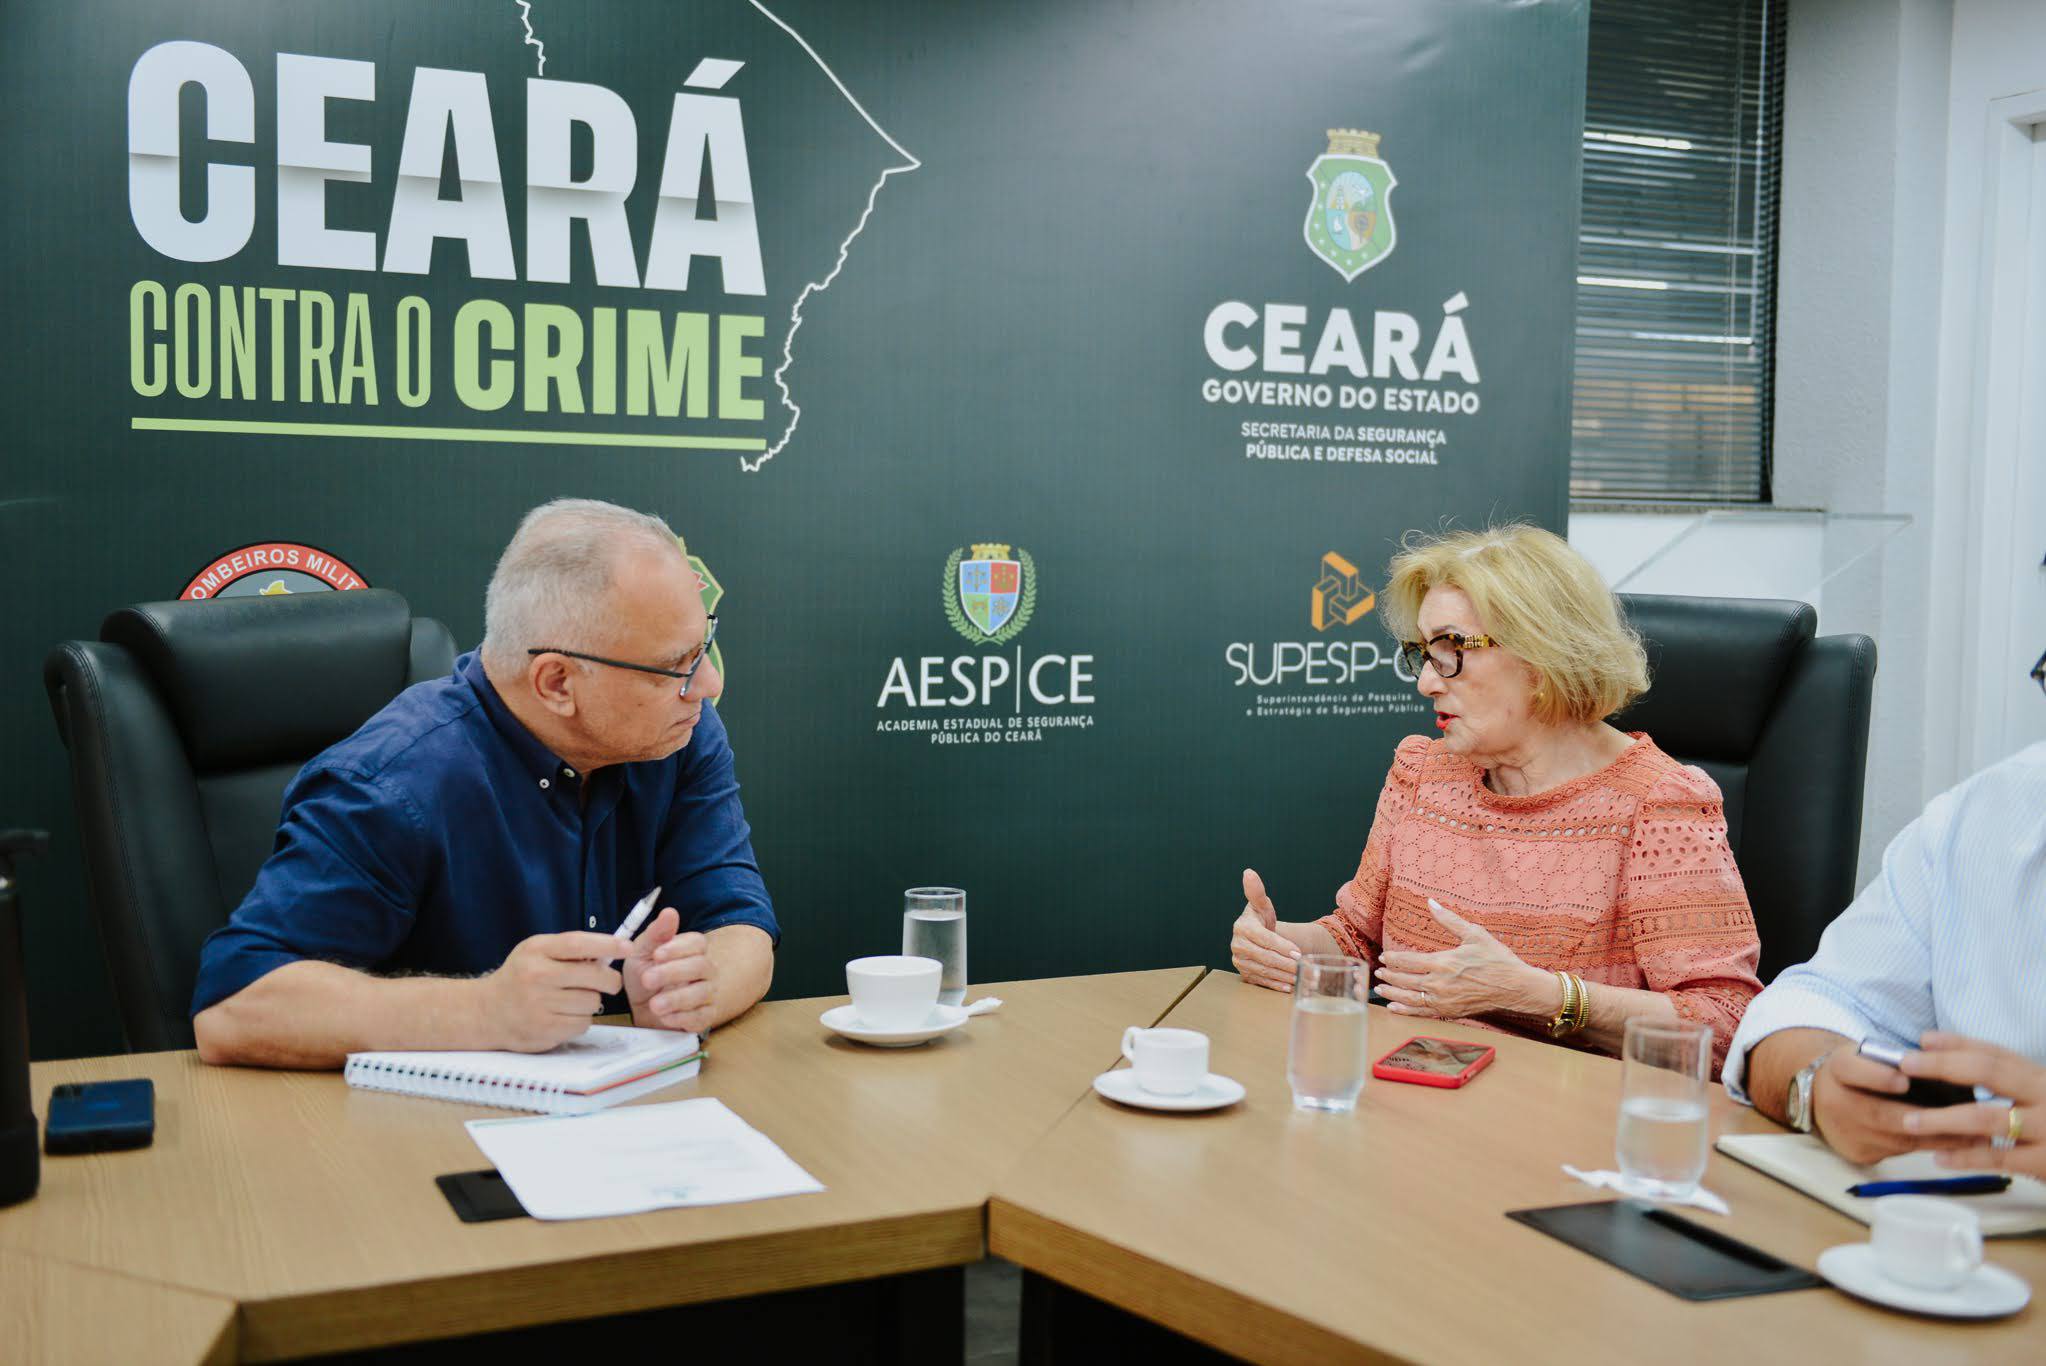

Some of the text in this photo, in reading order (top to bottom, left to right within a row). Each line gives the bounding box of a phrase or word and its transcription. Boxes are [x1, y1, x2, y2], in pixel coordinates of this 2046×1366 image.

[128, 40, 767, 296] CEARÁ
[129, 280, 766, 421] CONTRA O CRIME
[1203, 290, 1481, 385] CEARÁ
[1201, 378, 1480, 415] GOVERNO DO ESTADO
[1241, 421, 1447, 449] SECRETARIA DA SEGURANÇA
[1246, 439, 1438, 465] PÚBLICA E DEFESA SOCIAL
[190, 548, 360, 600] OMBEIROS MILIT
[1225, 641, 1418, 687] SUPESP-C
[876, 715, 1094, 732] ACADEMIA ESTADUAL DE SEGURANÇA
[931, 728, 1042, 744] PÚBLICA DO CEARÁ
